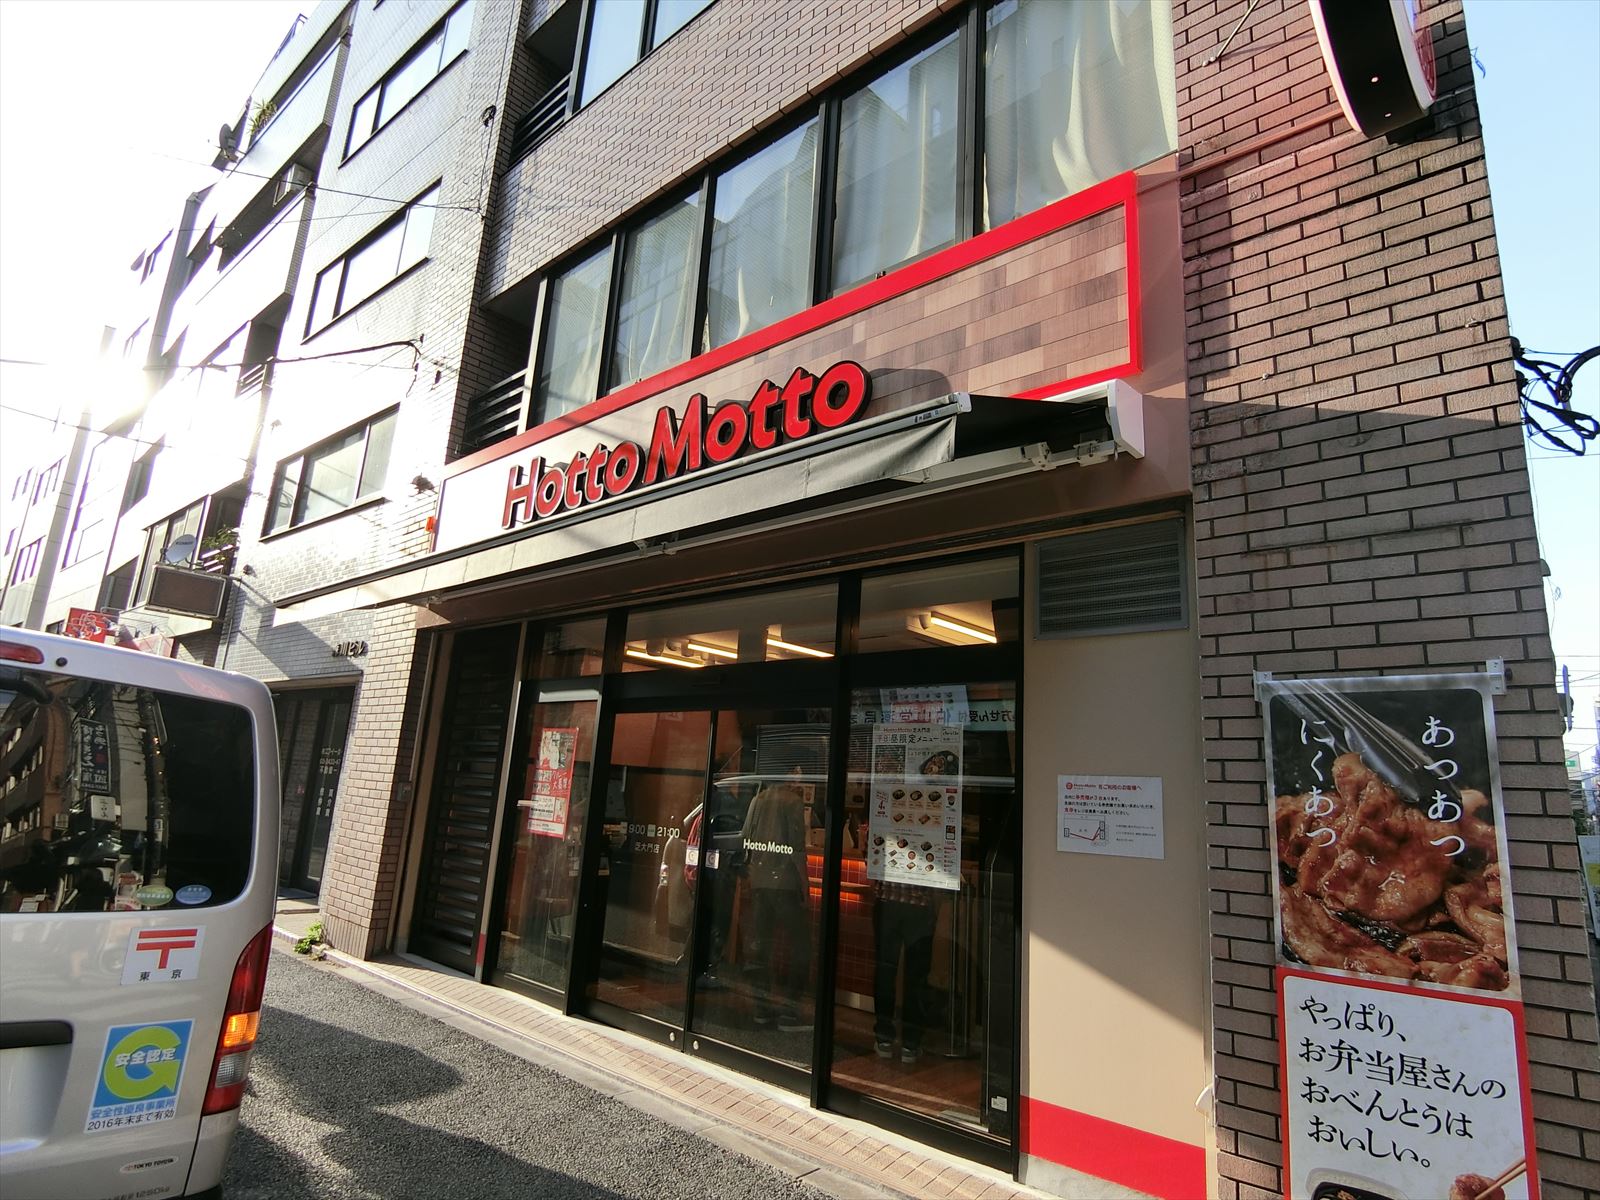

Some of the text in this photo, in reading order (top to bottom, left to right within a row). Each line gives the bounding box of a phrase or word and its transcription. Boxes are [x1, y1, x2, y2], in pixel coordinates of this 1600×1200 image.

[1301, 718, 1337, 847] にくあつ
[1421, 715, 1466, 857] あつあつ
[657, 826, 680, 839] 21:00
[140, 969, 182, 982] 東京
[1300, 995, 1407, 1042] やっぱり、
[114, 1047, 177, 1068] 安全認定
[1299, 1037, 1506, 1099] お弁当屋さんの
[87, 1109, 175, 1131] 2016年末まで有効
[91, 1099, 176, 1120] 安全性優良事業所
[1300, 1076, 1474, 1139] おべんとうは
[1307, 1115, 1431, 1168] おいしい。
[133, 1157, 174, 1170] TOKYO TOYOTA
